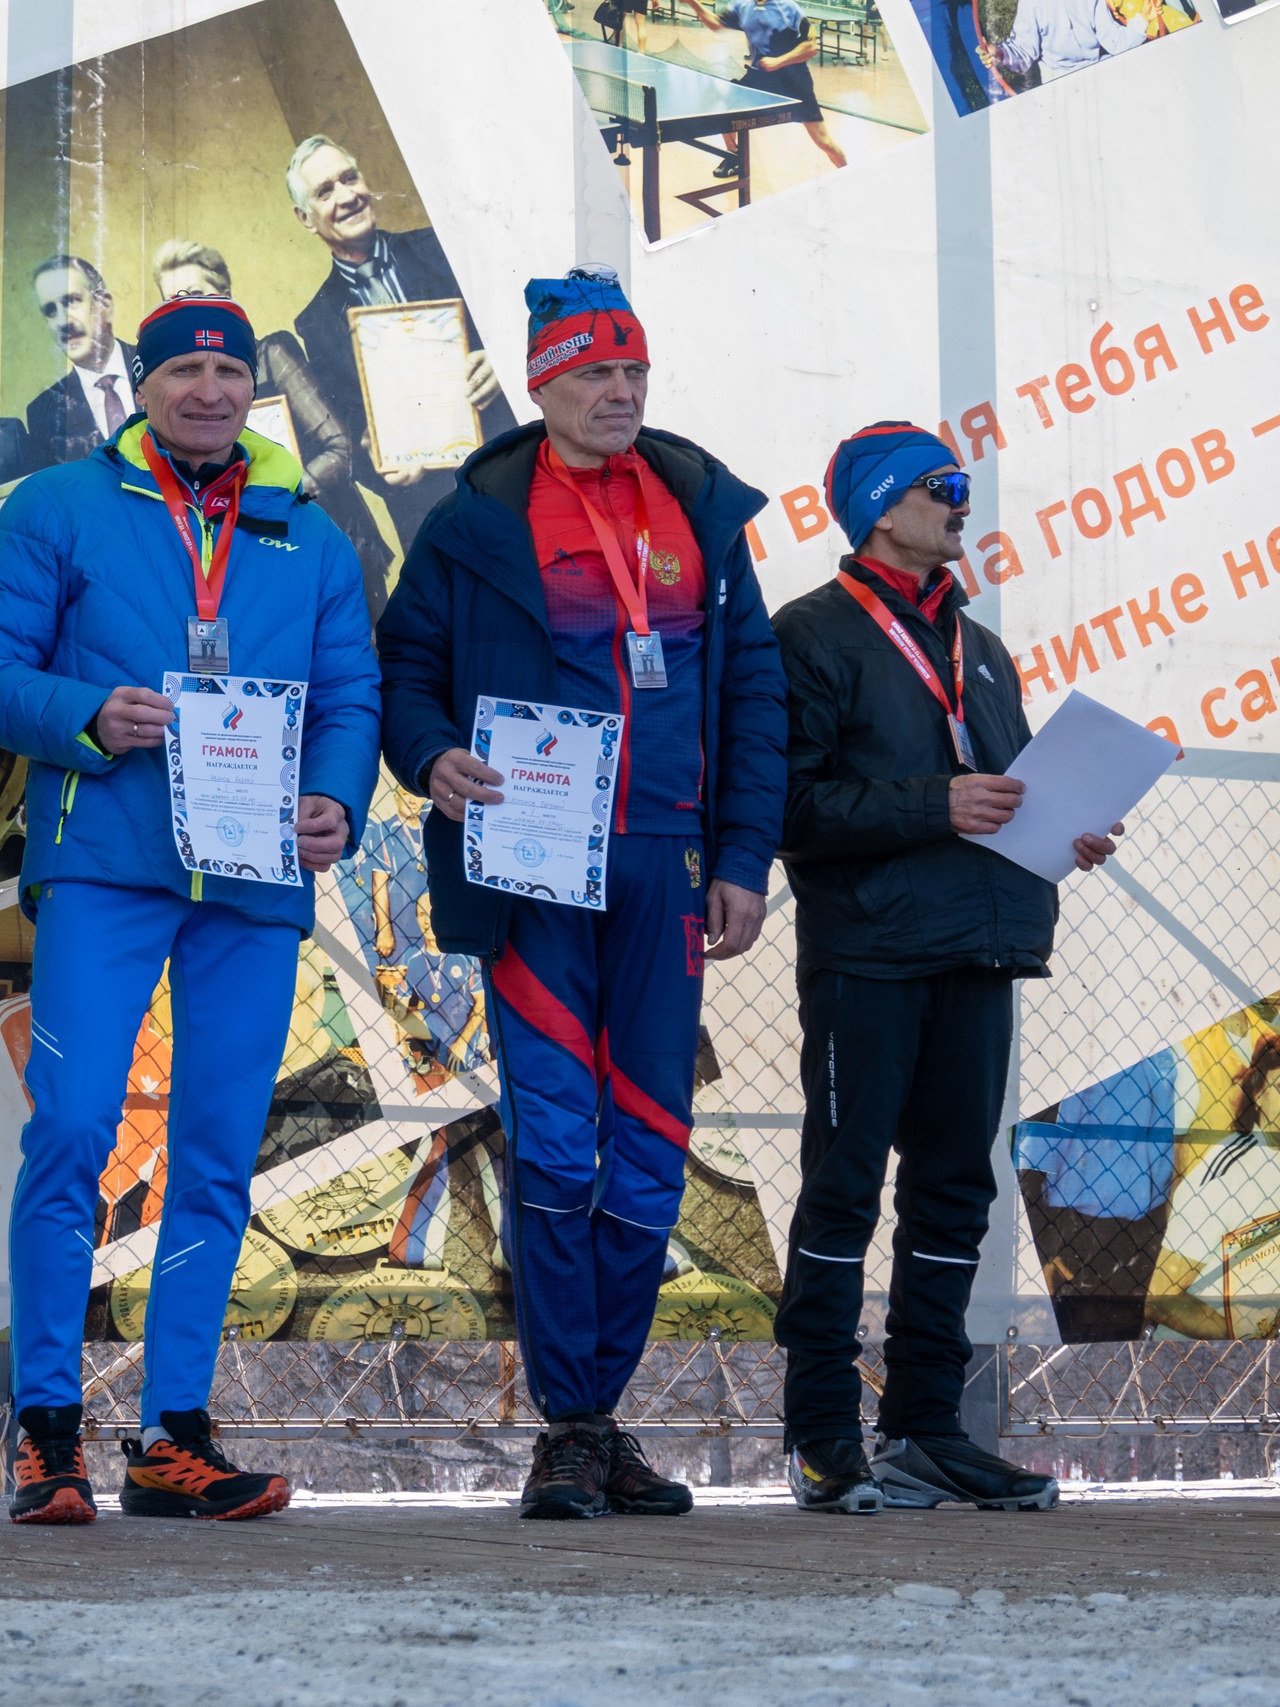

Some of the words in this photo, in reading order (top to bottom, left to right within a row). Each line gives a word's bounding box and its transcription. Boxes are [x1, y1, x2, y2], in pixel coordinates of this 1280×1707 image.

[558, 333, 593, 354] КОНЬ
[1016, 321, 1178, 430] тебя
[1186, 283, 1271, 355] не
[870, 474, 896, 501] OLLY
[1035, 428, 1236, 539] годов
[1200, 655, 1280, 739] са
[202, 744, 259, 759] ГРАМОТА
[206, 761, 258, 771] НАГРАЖДАЕТСЯ
[510, 768, 571, 787] ГРАМОТА
[513, 785, 569, 797] НАГРАЖДАЕТСЯ
[1239, 1244, 1280, 1270] ГРАМОТ
[333, 1274, 395, 1308] СПАРТАКИАДА
